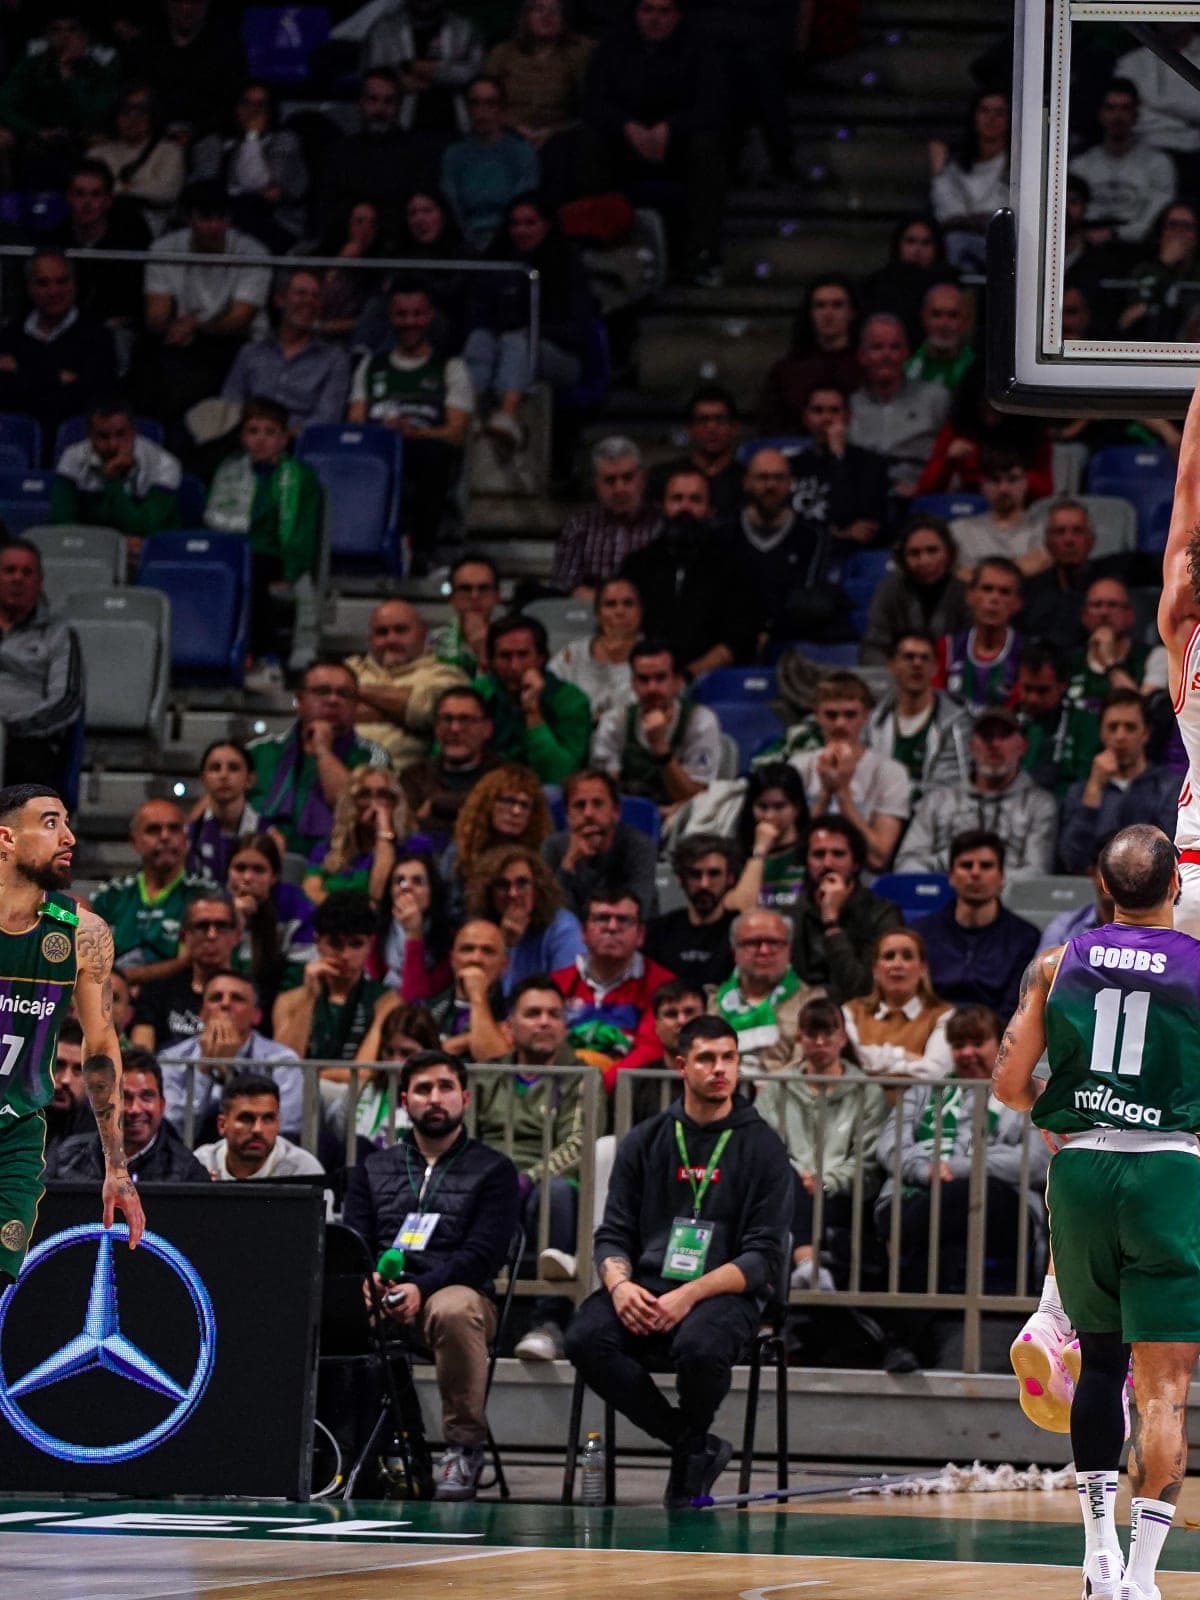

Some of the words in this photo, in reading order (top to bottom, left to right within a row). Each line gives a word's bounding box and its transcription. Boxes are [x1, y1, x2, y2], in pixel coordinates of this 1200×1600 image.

[1089, 945, 1167, 974] COBBS
[1090, 987, 1151, 1076] 11
[1074, 1084, 1162, 1126] málaga
[1087, 1482, 1106, 1520] UNICAJA
